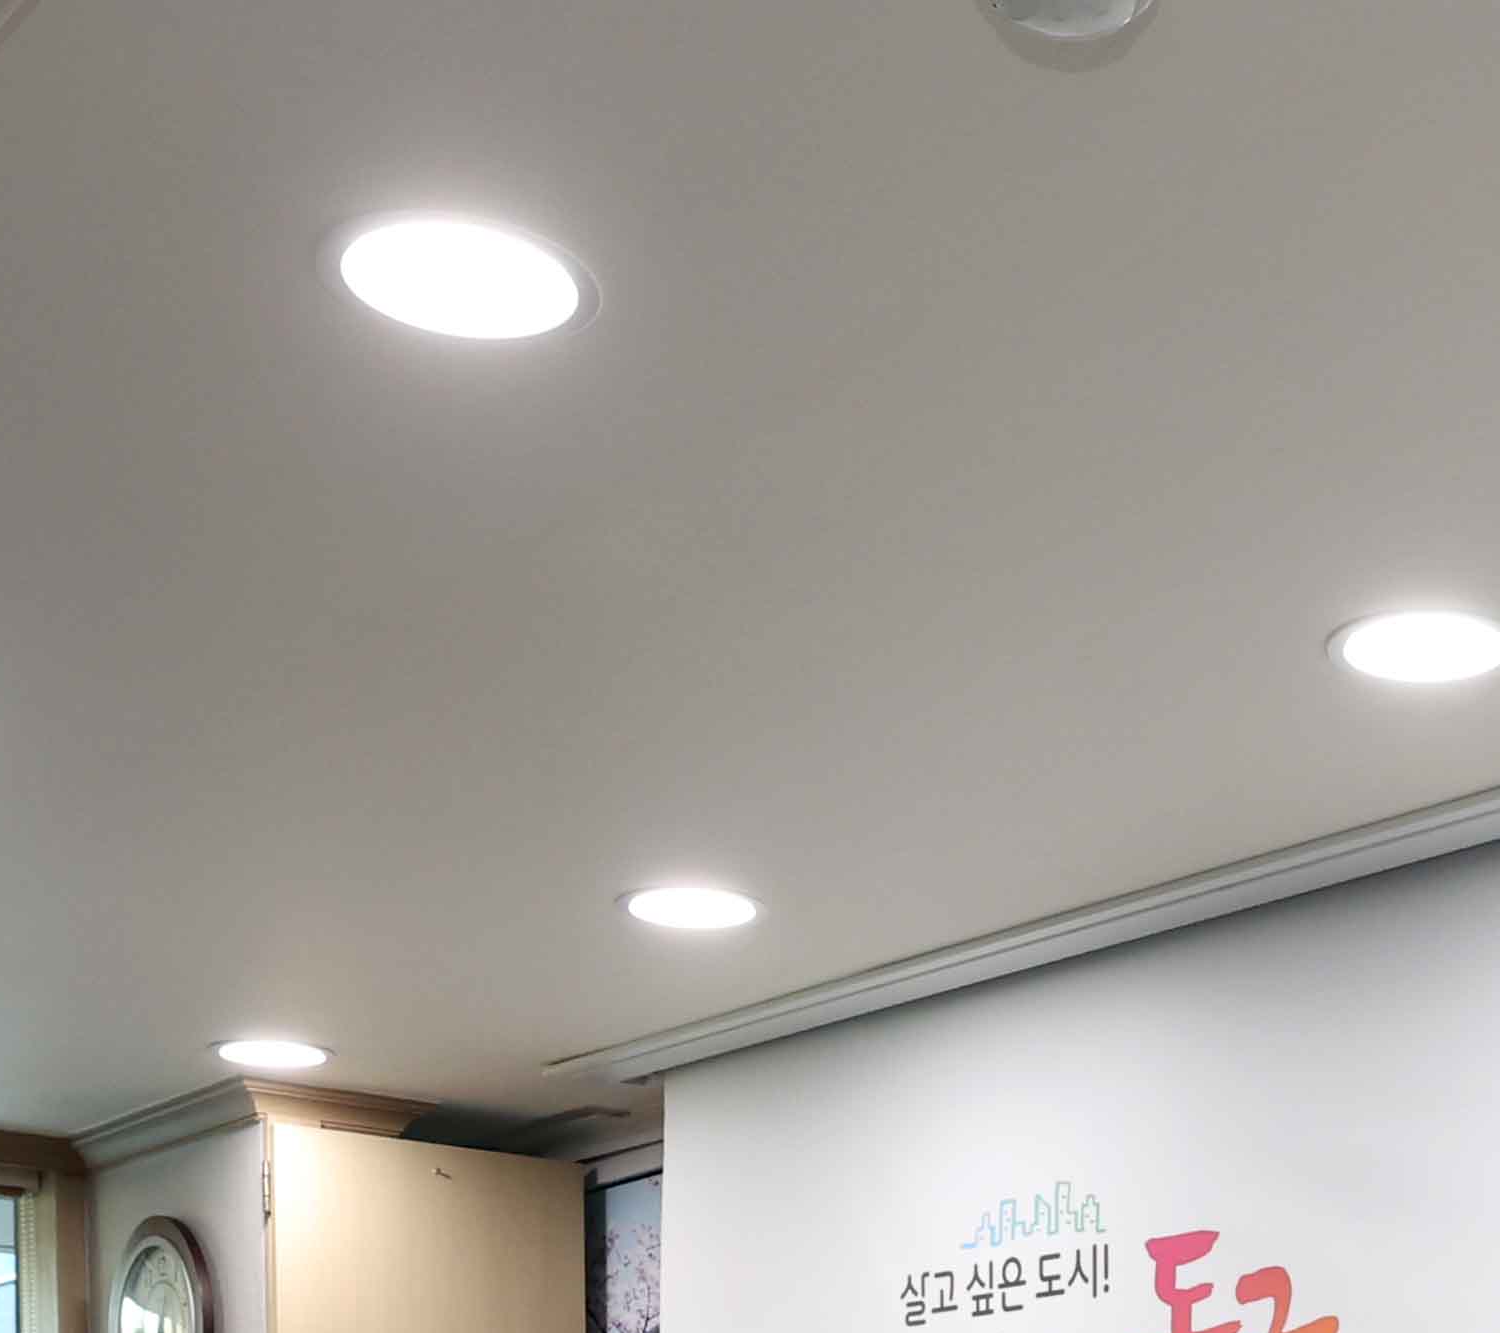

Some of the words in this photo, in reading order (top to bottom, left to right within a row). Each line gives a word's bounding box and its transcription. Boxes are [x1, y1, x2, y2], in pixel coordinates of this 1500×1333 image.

[899, 1269, 958, 1327] 살고
[966, 1255, 1028, 1319] 싶은
[1035, 1243, 1111, 1299] 도시!
